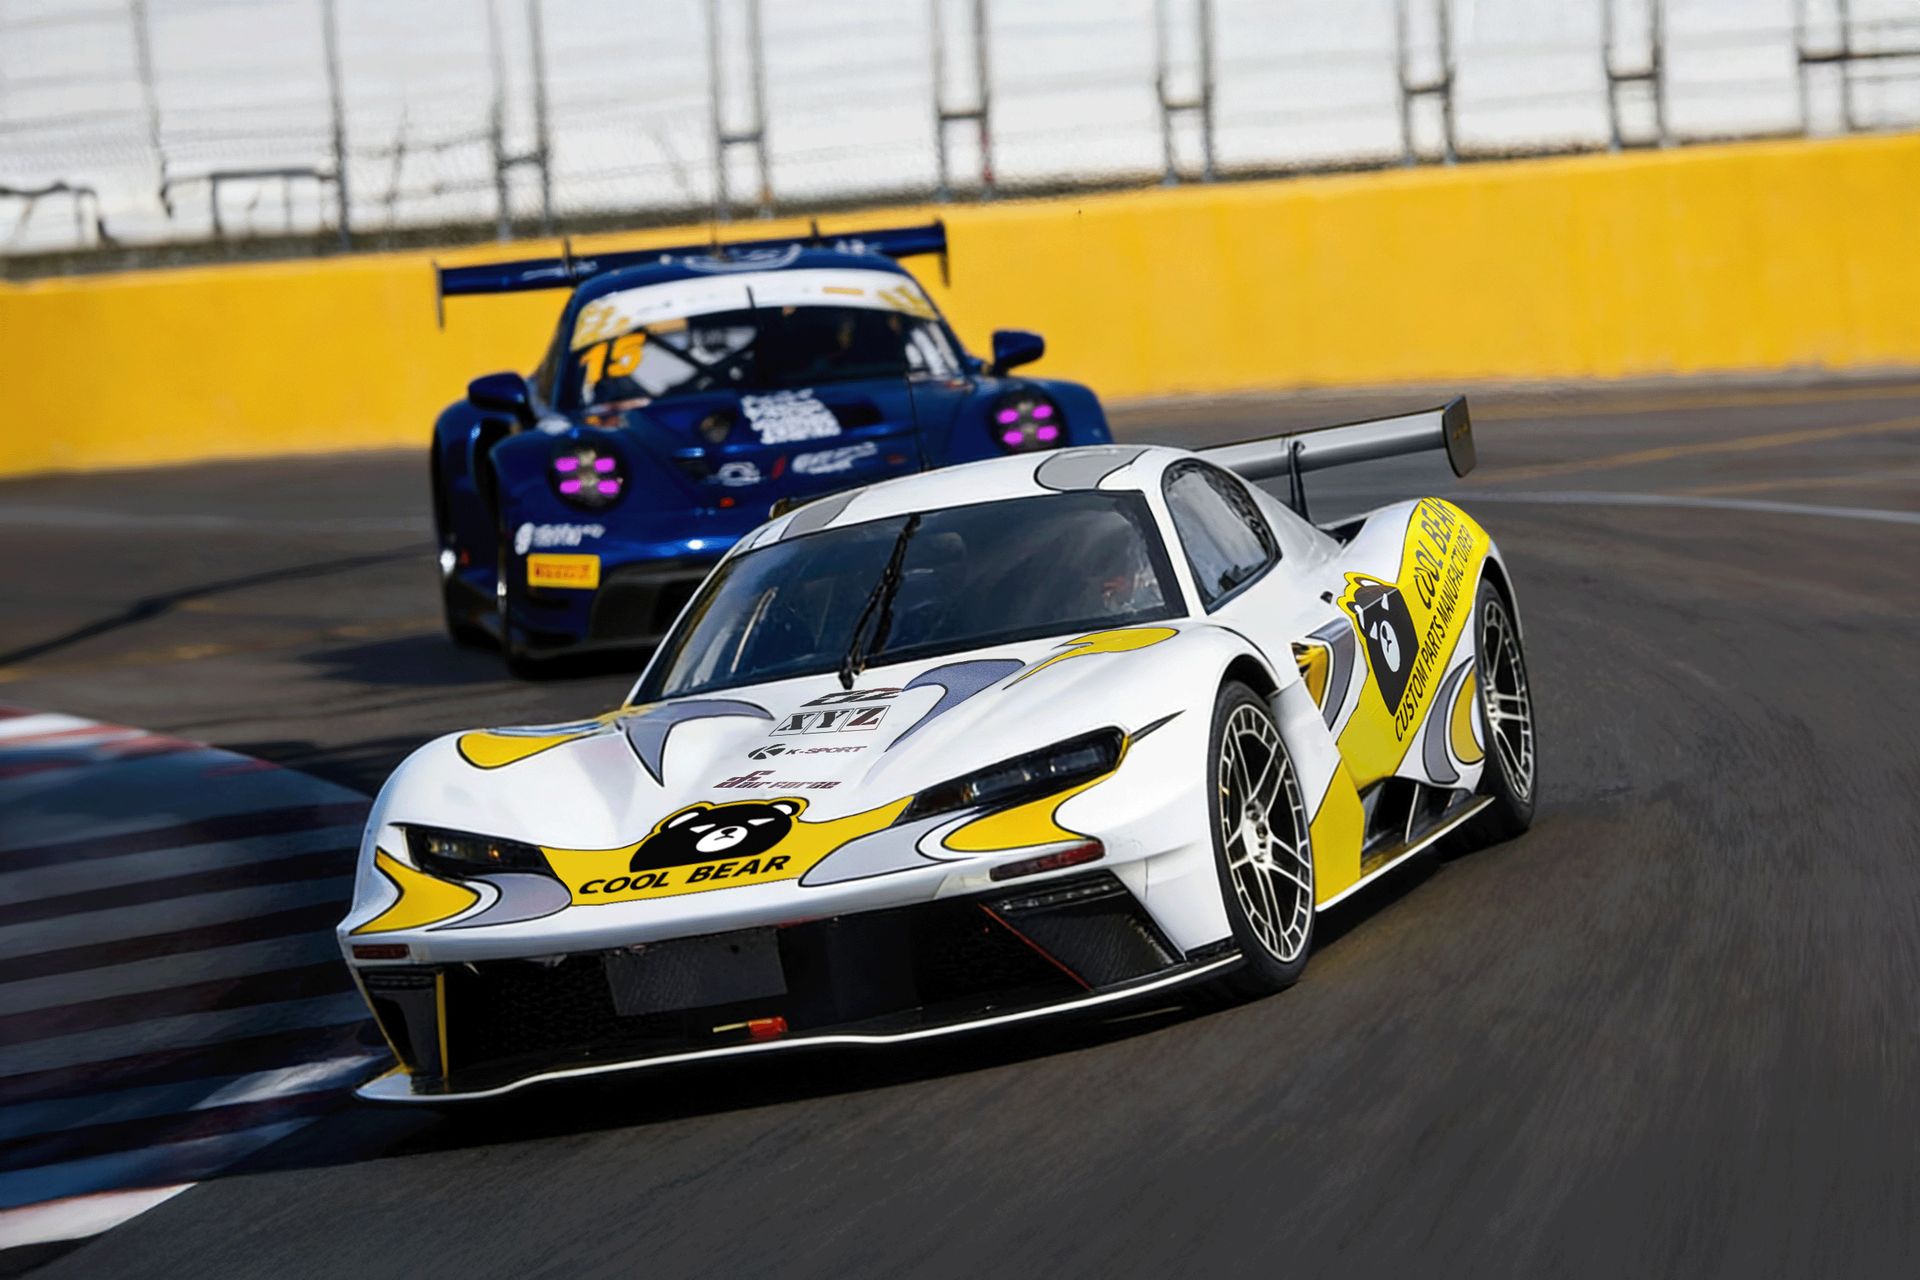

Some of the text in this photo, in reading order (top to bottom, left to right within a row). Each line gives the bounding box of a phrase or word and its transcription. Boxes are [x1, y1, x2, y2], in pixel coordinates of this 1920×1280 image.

[578, 331, 647, 388] 15
[1413, 540, 1443, 610] COOL
[1395, 524, 1474, 742] CUSTOM PARTS MANUFACTURER
[778, 707, 886, 731] XYZ
[579, 855, 791, 895] COOL BEAR
